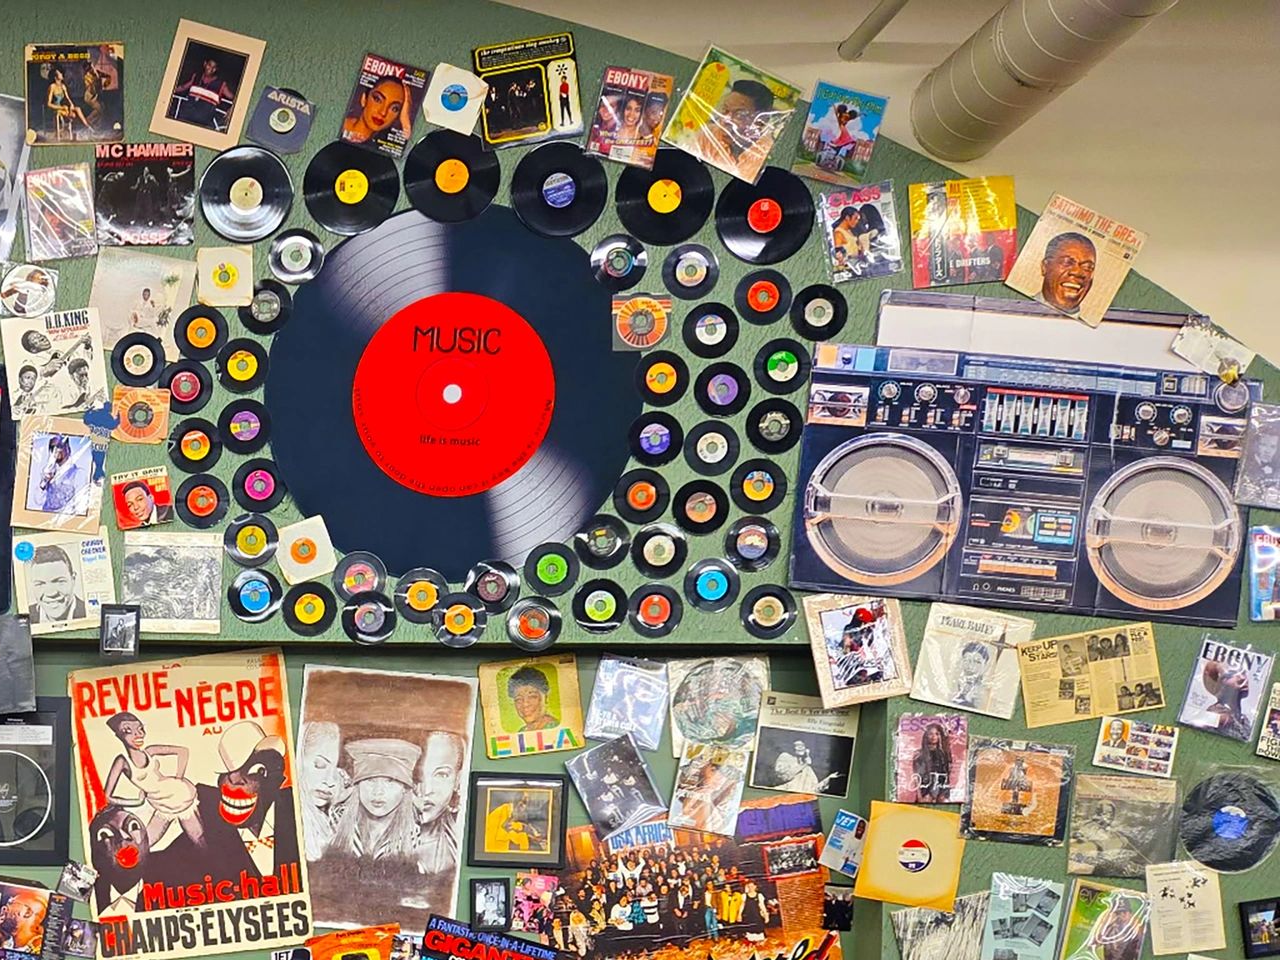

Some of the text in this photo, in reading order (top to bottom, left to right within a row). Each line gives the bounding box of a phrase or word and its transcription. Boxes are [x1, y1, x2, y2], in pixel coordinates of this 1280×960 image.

[363, 55, 405, 78] EBONY
[607, 70, 648, 89] EBONY
[267, 90, 311, 115] ARISTA
[126, 143, 193, 158] HAMMER
[829, 186, 881, 207] CLASS
[413, 326, 501, 356] MUSIC
[449, 436, 481, 446] music
[1021, 640, 1058, 657] KEEP UP
[1203, 641, 1269, 672] EBONY
[78, 670, 172, 720] REVUE
[203, 726, 222, 736] AU
[491, 728, 578, 757] ELLA
[636, 820, 674, 845] AFRICA
[836, 815, 857, 829] JET
